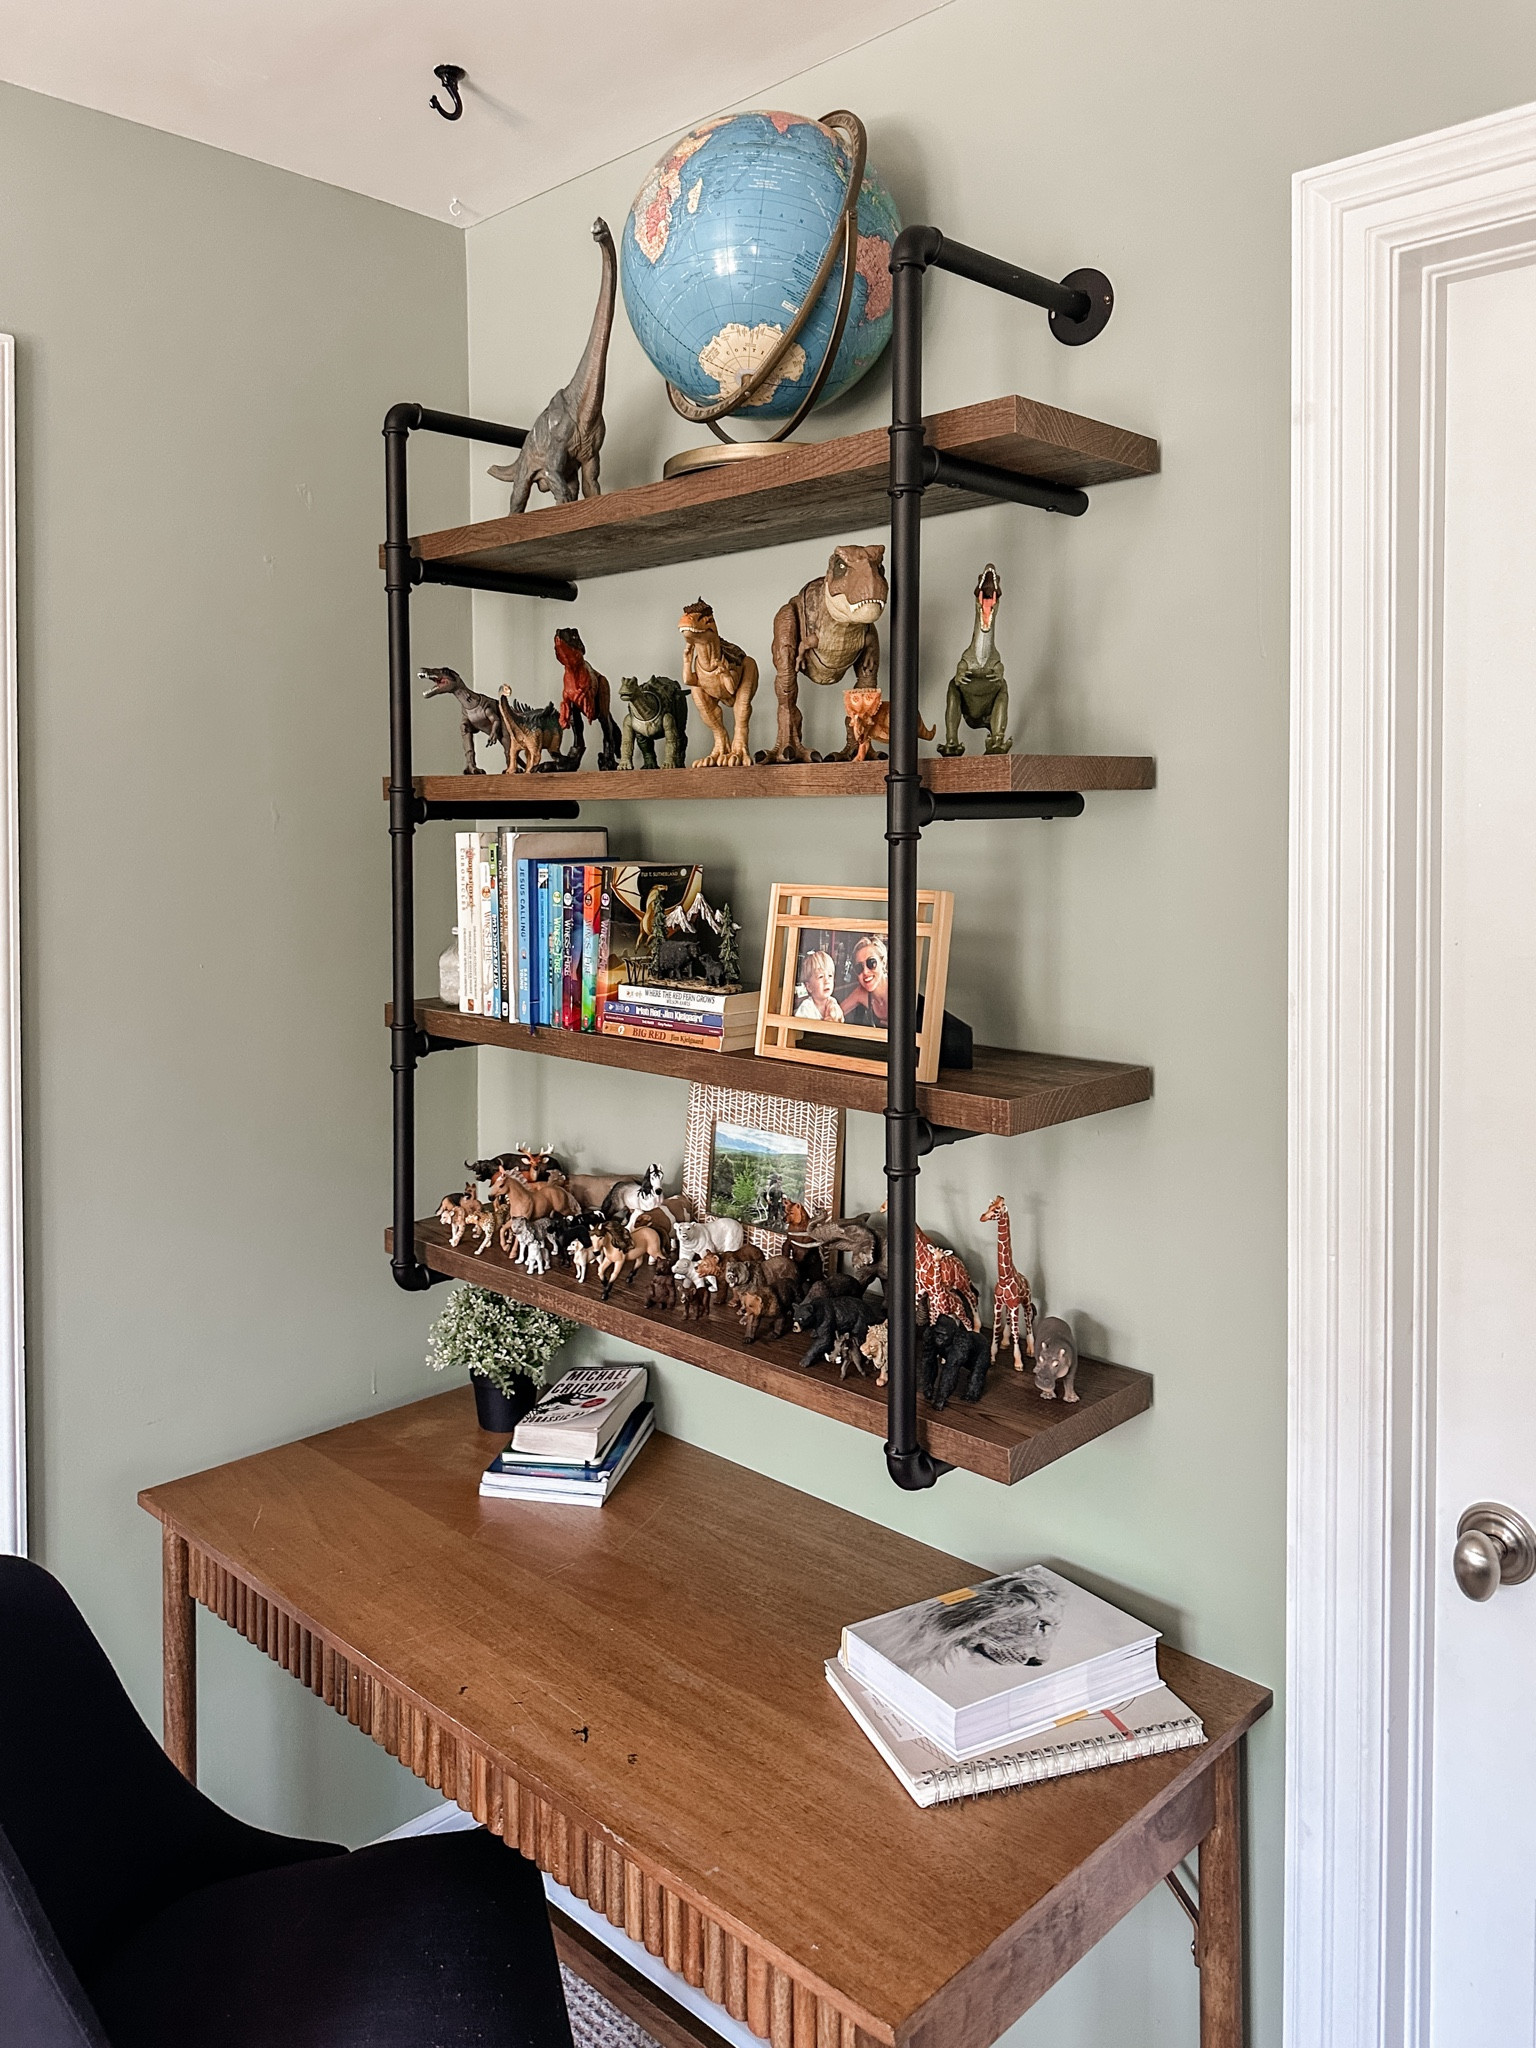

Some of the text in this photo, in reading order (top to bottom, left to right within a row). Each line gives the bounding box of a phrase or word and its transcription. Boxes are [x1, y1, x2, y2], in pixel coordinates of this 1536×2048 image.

[519, 898, 527, 939] CALLING
[563, 919, 572, 948] WINGS
[563, 955, 572, 976] FIRE
[645, 989, 715, 1004] WHERE THE RED FERN GROWS
[635, 1006, 649, 1016] Irish
[674, 1011, 703, 1023] Kjelgaard
[632, 1027, 704, 1046] BIG RED Jim Kjelgaard
[566, 1369, 632, 1381] MICHAEL
[551, 1380, 627, 1394] CRICHTON
[522, 1413, 570, 1423] JURASSIC
